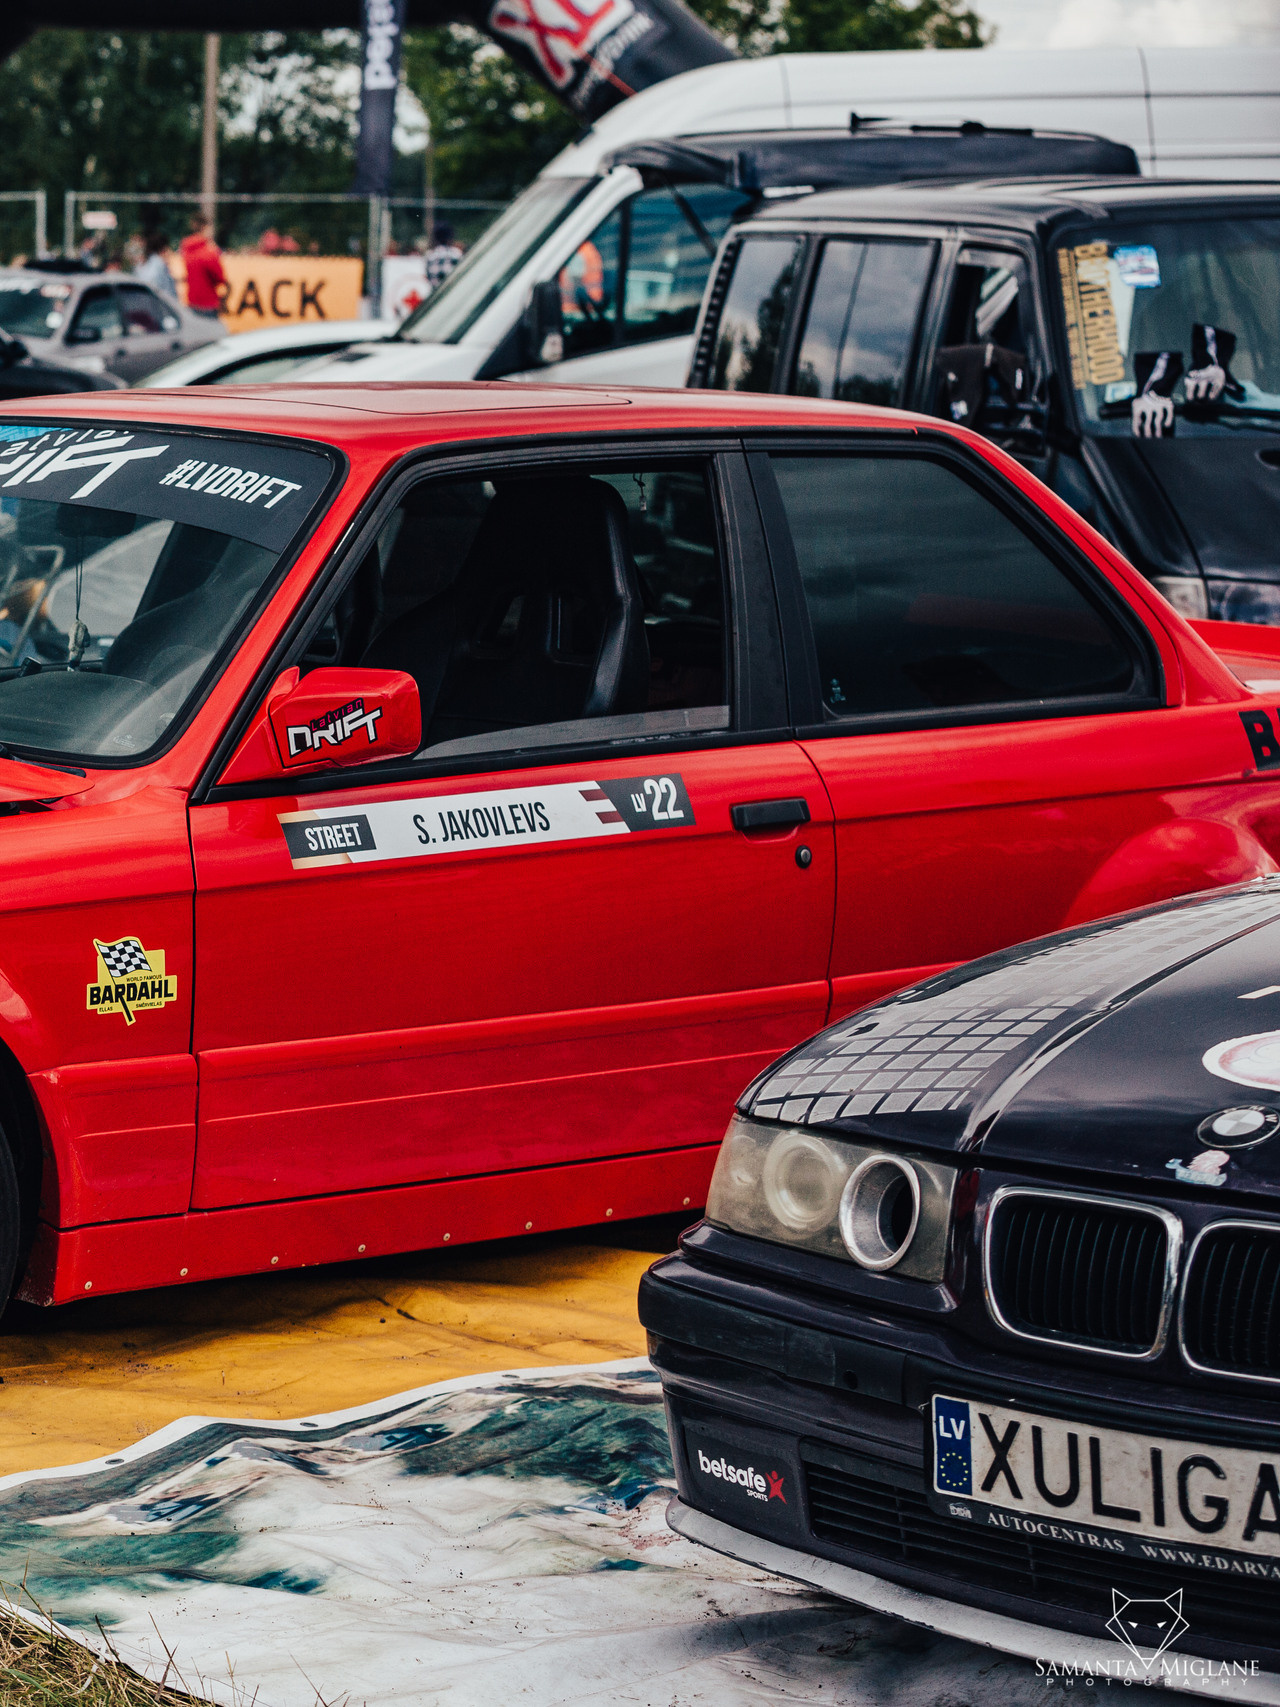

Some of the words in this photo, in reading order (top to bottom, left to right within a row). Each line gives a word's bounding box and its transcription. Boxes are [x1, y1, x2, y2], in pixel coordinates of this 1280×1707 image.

[158, 459, 303, 509] #LVDRIFT
[287, 708, 381, 756] DRIFT
[305, 822, 361, 852] STREET
[412, 813, 438, 846] S.
[441, 801, 552, 843] JAKOVLEVS
[89, 979, 175, 1006] BARDAHL
[143, 973, 163, 981] FAMOUS
[938, 1415, 966, 1440] LV
[698, 1449, 767, 1493] betsafe
[746, 1489, 769, 1502] SPORTS
[987, 1512, 1126, 1552] AUTOCENTRAS
